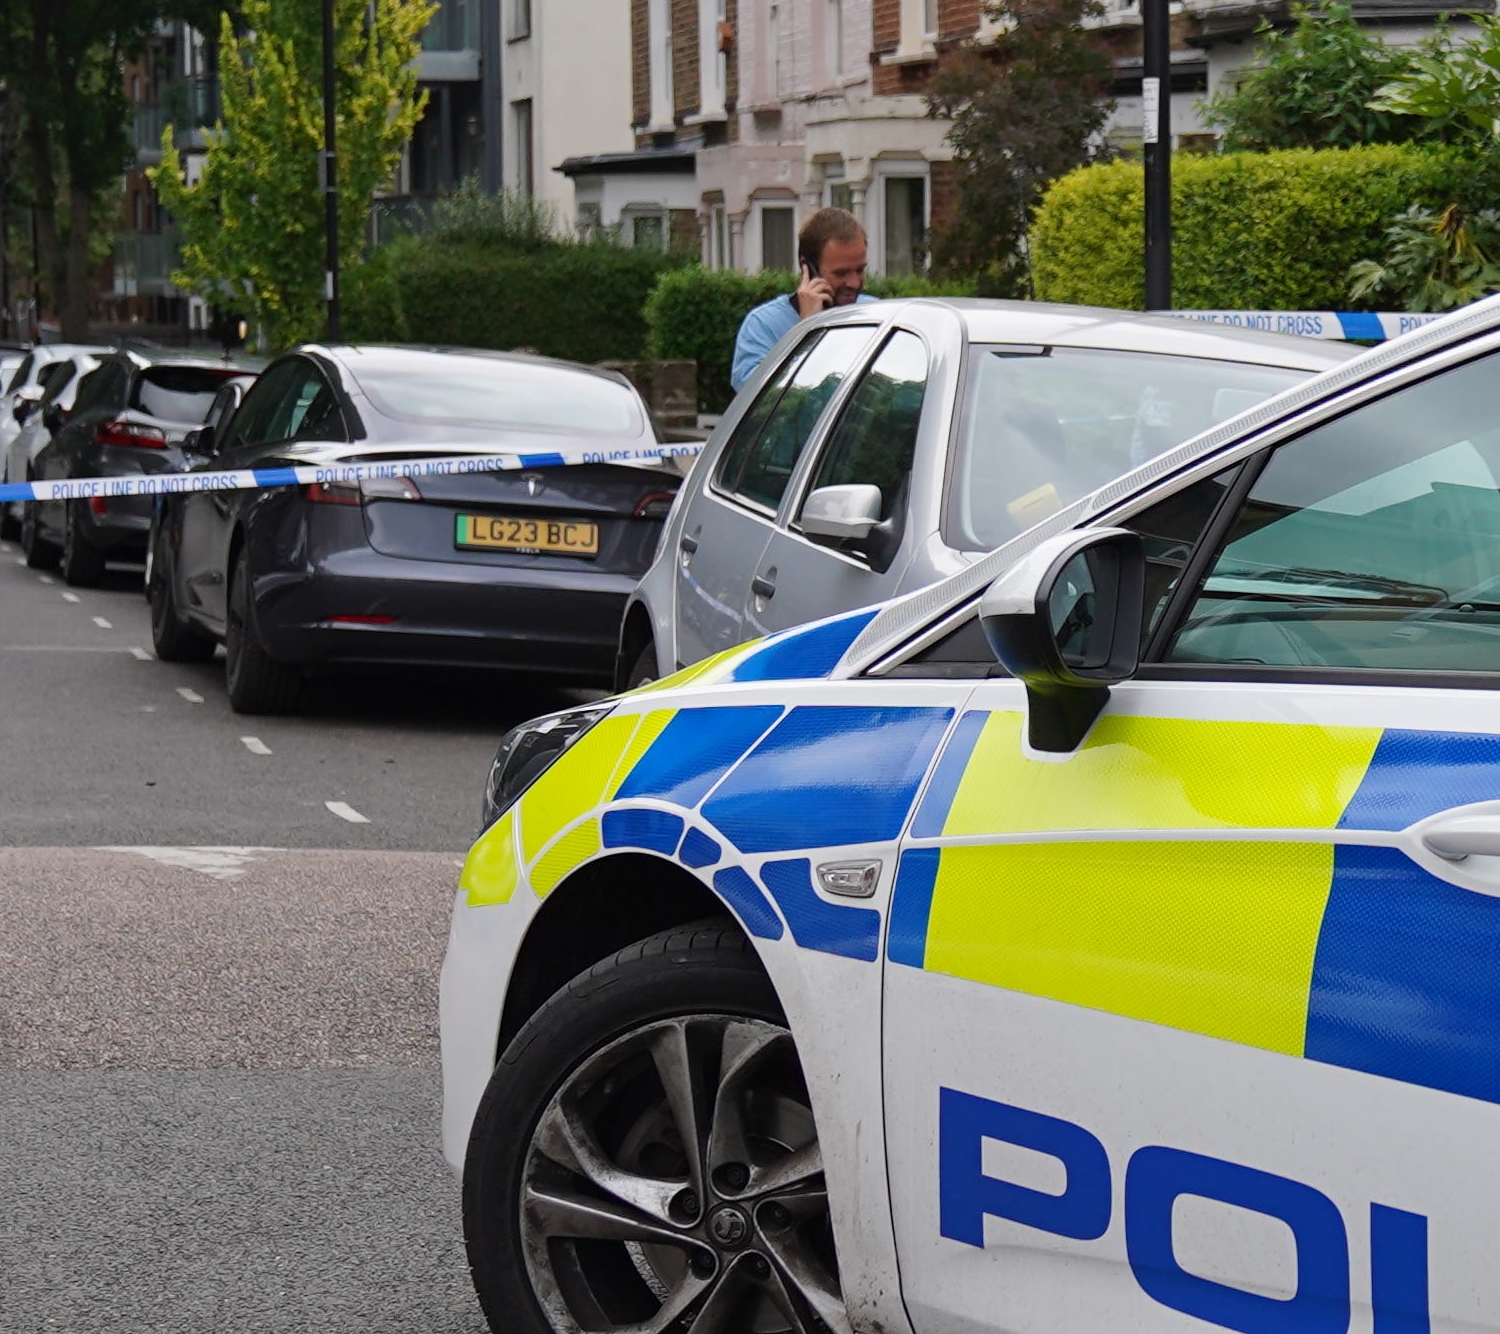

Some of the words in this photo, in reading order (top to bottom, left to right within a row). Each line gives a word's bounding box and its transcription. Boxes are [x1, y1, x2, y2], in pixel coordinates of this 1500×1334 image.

[1277, 315, 1323, 335] CROSS
[316, 468, 363, 484] POLICE
[403, 464, 421, 478] DO
[426, 461, 453, 475] NOT
[458, 458, 503, 473] CROSS
[52, 482, 98, 499] POLICE
[104, 481, 132, 497] LINE
[138, 479, 156, 495] DO
[161, 477, 187, 493] NOT
[192, 474, 238, 490] CROSS
[472, 517, 539, 544] LG23
[546, 522, 596, 548] BCJ
